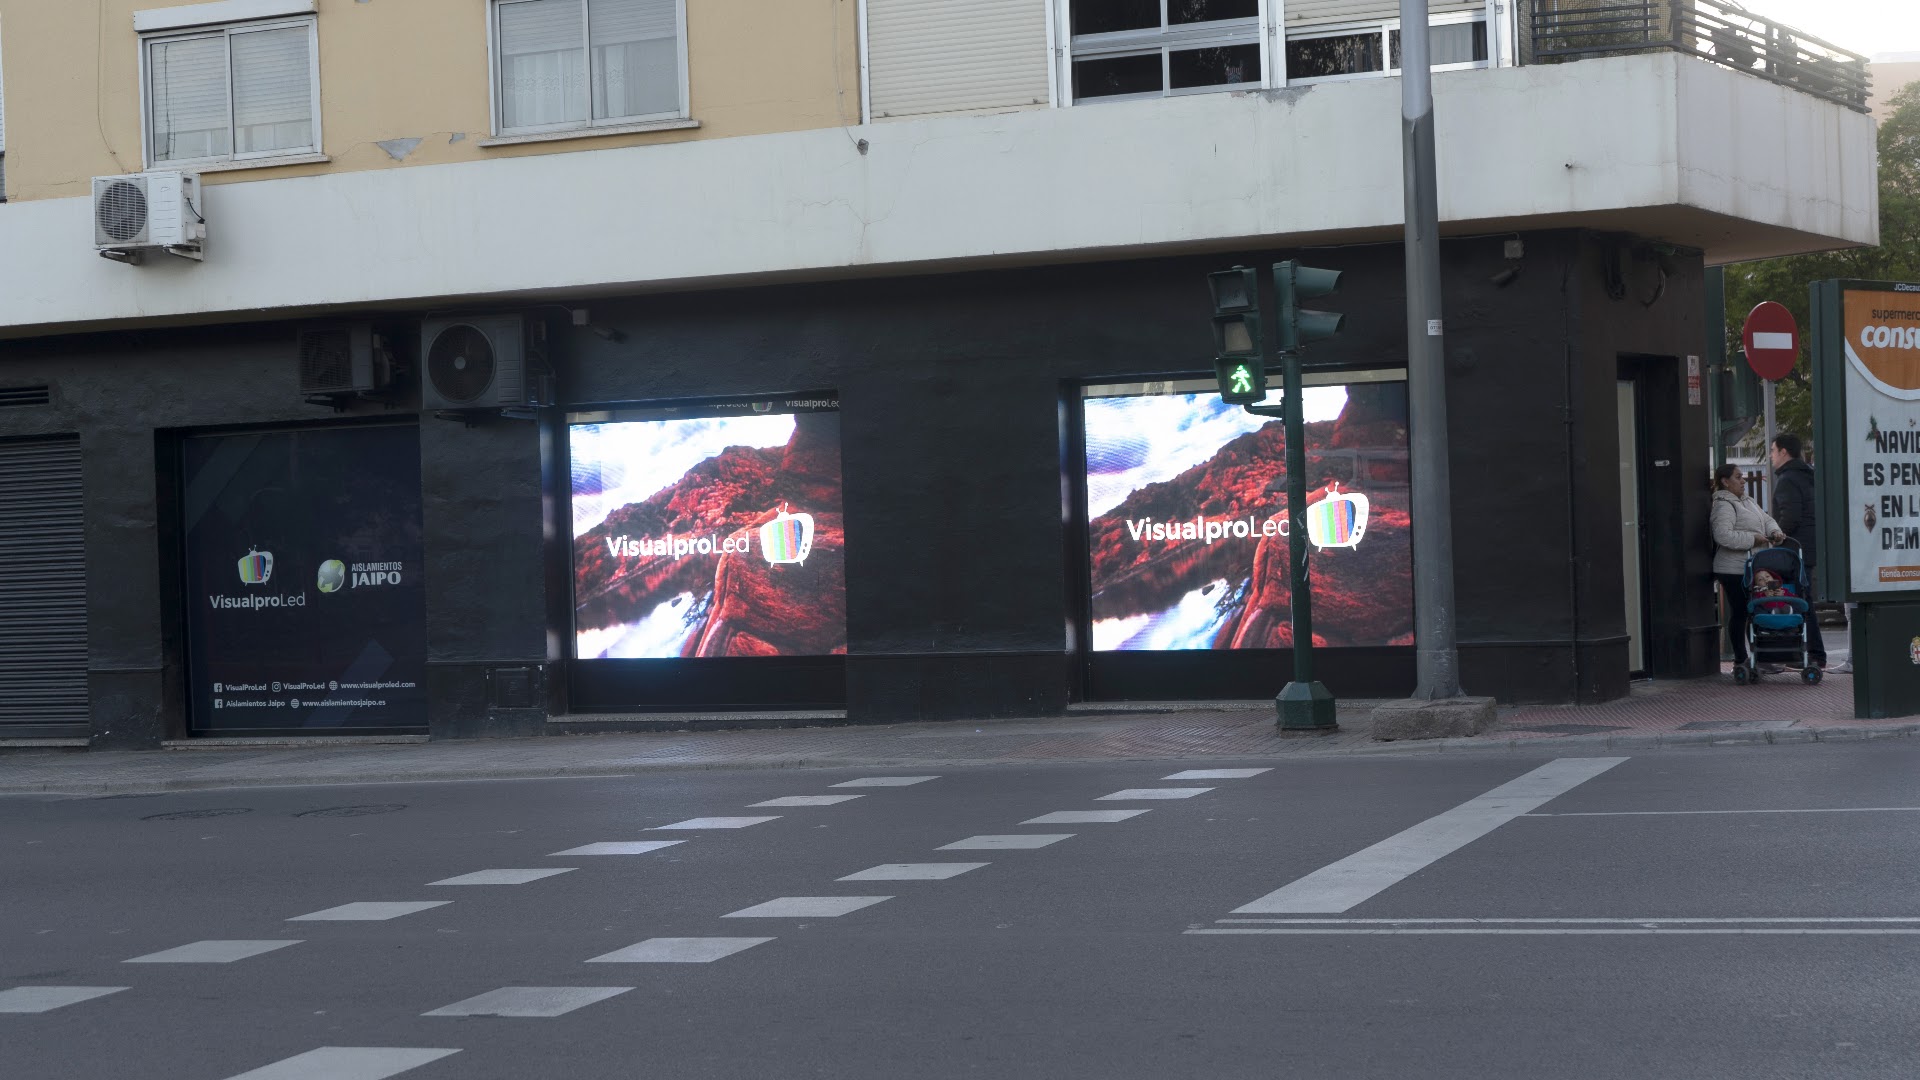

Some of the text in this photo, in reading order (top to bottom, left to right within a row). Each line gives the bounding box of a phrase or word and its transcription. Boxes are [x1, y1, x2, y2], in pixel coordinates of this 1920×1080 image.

[1863, 462, 1920, 486] ES PEN
[1881, 494, 1903, 518] EN
[606, 533, 750, 560] VisualproLed
[351, 561, 403, 572] AISLAMIENTOS
[351, 571, 402, 589] JAIPO
[209, 592, 306, 611] VisualproLed
[225, 683, 267, 691] VisualProLed
[283, 682, 326, 690] VisualProLed
[340, 681, 416, 690] www.visualproled.com
[226, 700, 286, 708] Aislamientos Jaipo
[302, 699, 386, 708] www.aislamientosjaipo.es
